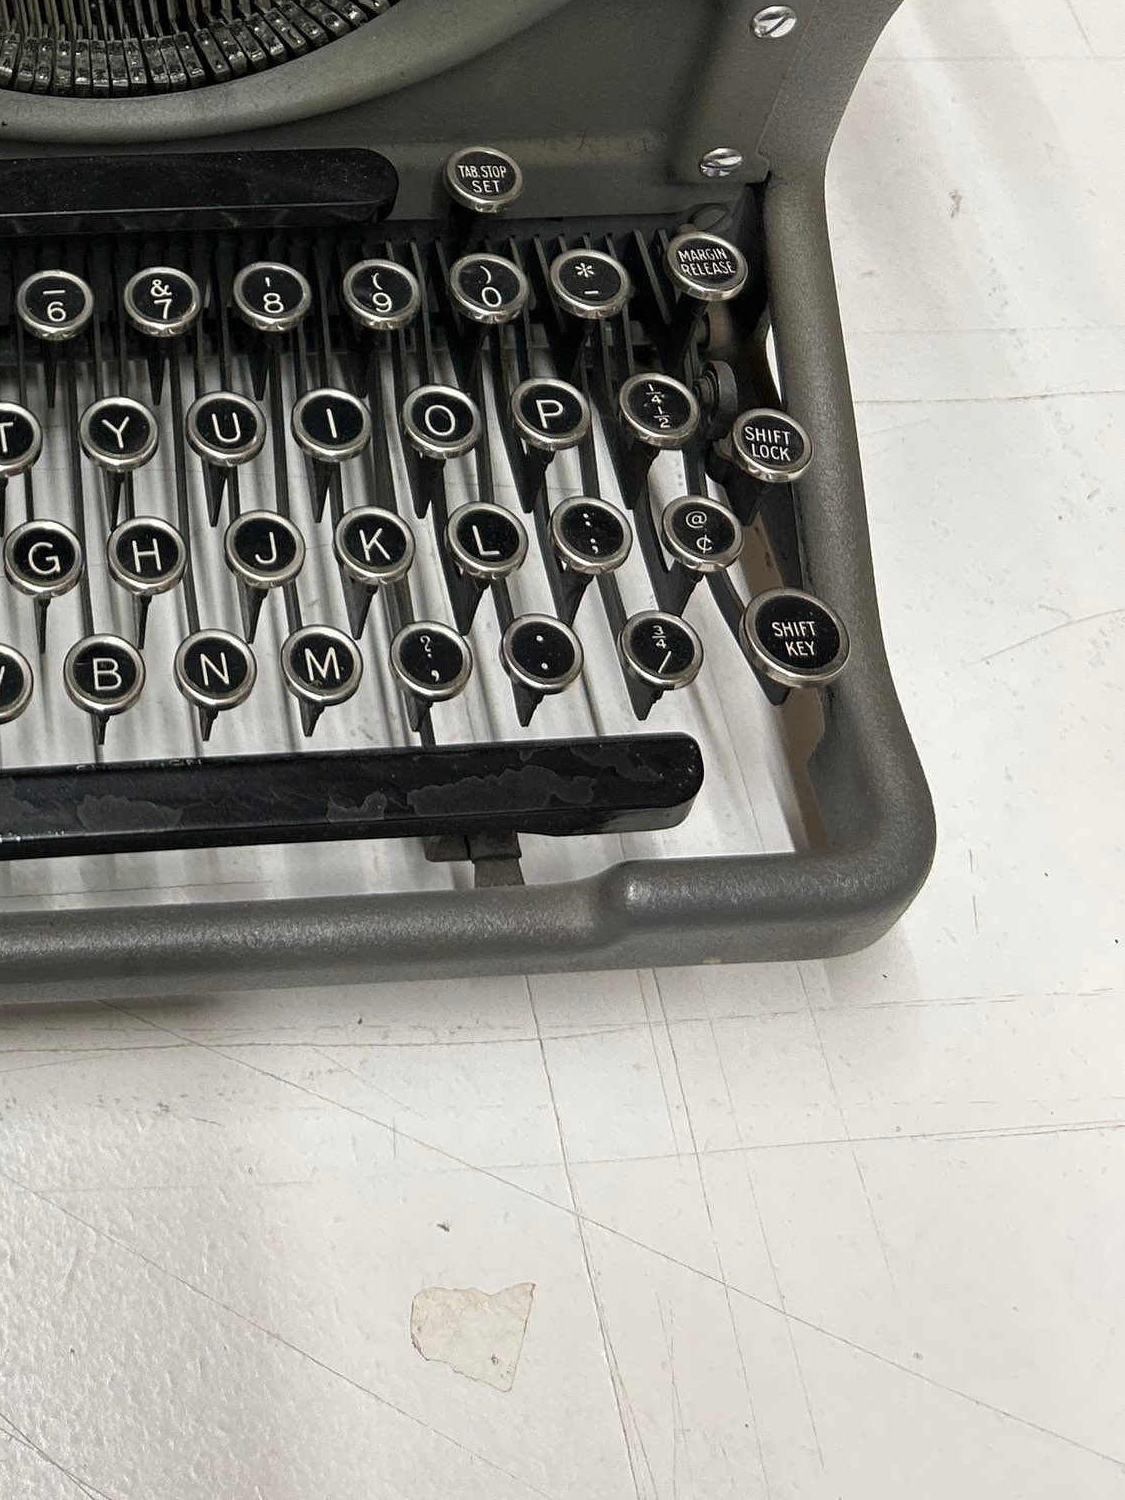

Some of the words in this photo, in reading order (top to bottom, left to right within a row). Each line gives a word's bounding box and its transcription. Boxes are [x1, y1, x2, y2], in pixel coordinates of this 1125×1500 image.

[480, 165, 506, 178] STOP
[472, 180, 500, 193] SET
[677, 248, 727, 262] MARGIN
[681, 262, 736, 275] RELEASE
[150, 278, 173, 298] &
[482, 286, 502, 307] 0
[47, 301, 67, 323] 6
[154, 298, 173, 320] 7
[263, 292, 285, 314] 8
[372, 292, 393, 313] 9
[326, 408, 338, 439] I
[425, 404, 456, 436] O
[537, 399, 564, 428] P
[101, 416, 130, 449] Y
[211, 412, 241, 443] U
[744, 426, 791, 442] SHIFT
[752, 445, 791, 460] LOCK
[685, 510, 708, 529] @
[254, 531, 277, 565] J
[359, 527, 391, 561] K
[471, 524, 500, 556] L
[27, 541, 61, 575] G
[132, 538, 162, 572] H
[771, 620, 816, 637] SHIFT
[419, 635, 432, 658] ?
[784, 640, 815, 656] KEY
[92, 657, 122, 691] B
[200, 651, 230, 686] N
[304, 646, 341, 682] M
